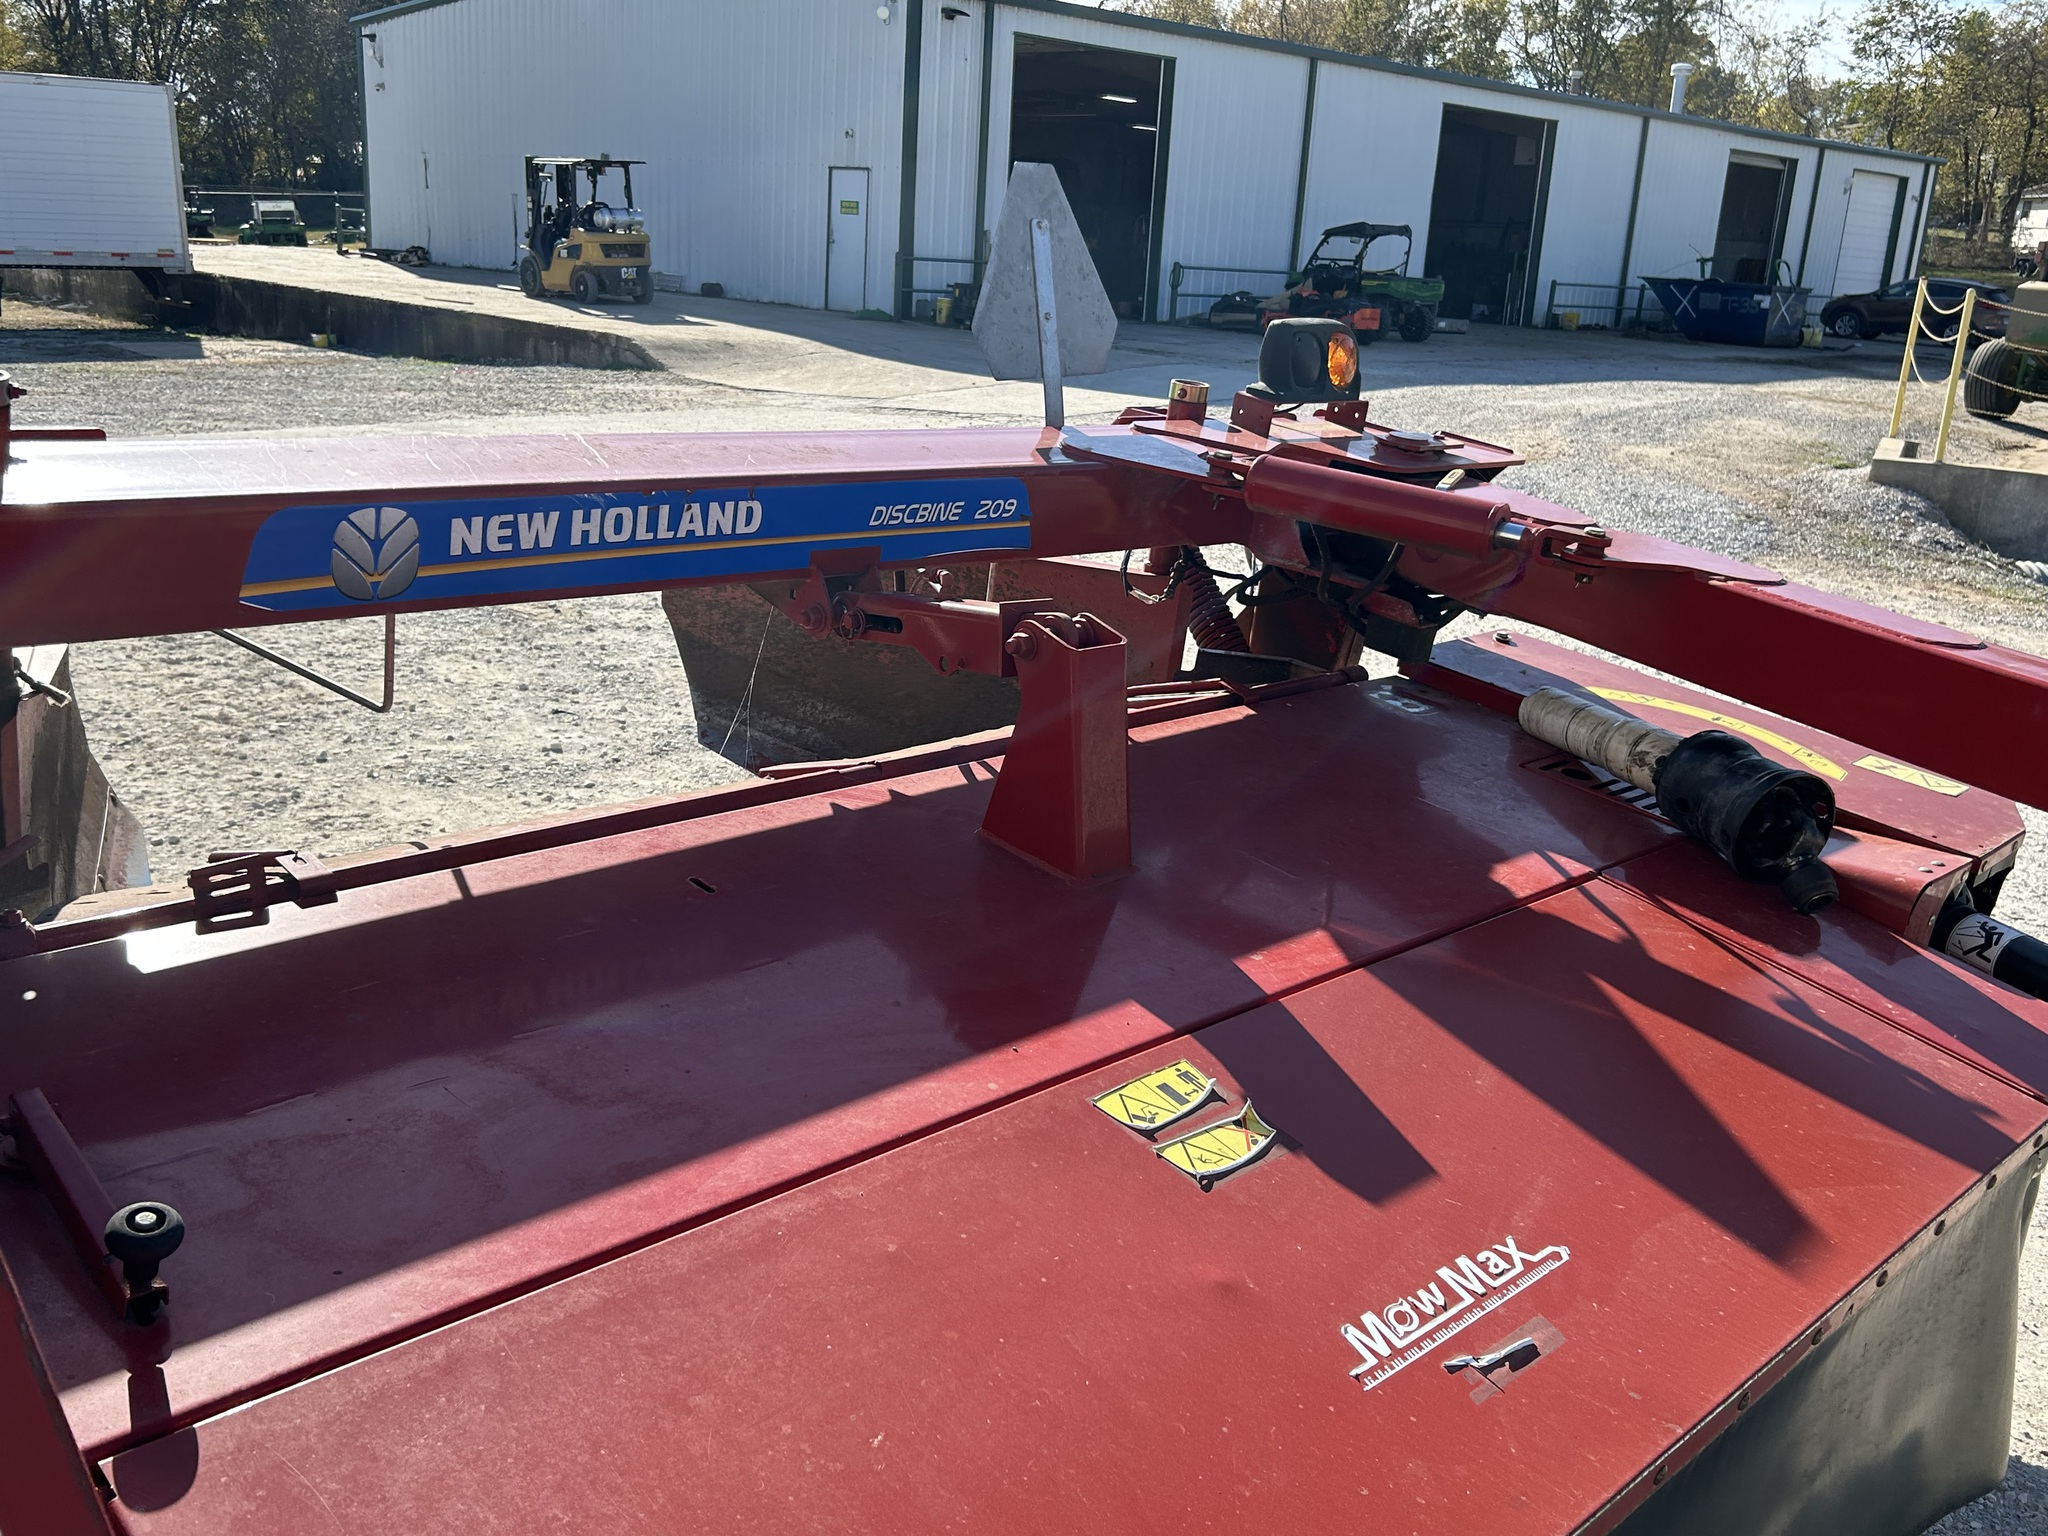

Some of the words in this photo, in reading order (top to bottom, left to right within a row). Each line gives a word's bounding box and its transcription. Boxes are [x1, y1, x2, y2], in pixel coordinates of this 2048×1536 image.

[621, 267, 637, 279] CAT
[868, 502, 966, 527] DISCBINE
[973, 498, 1018, 520] 209
[449, 511, 561, 556] NEW
[569, 500, 763, 546] HOLLAND
